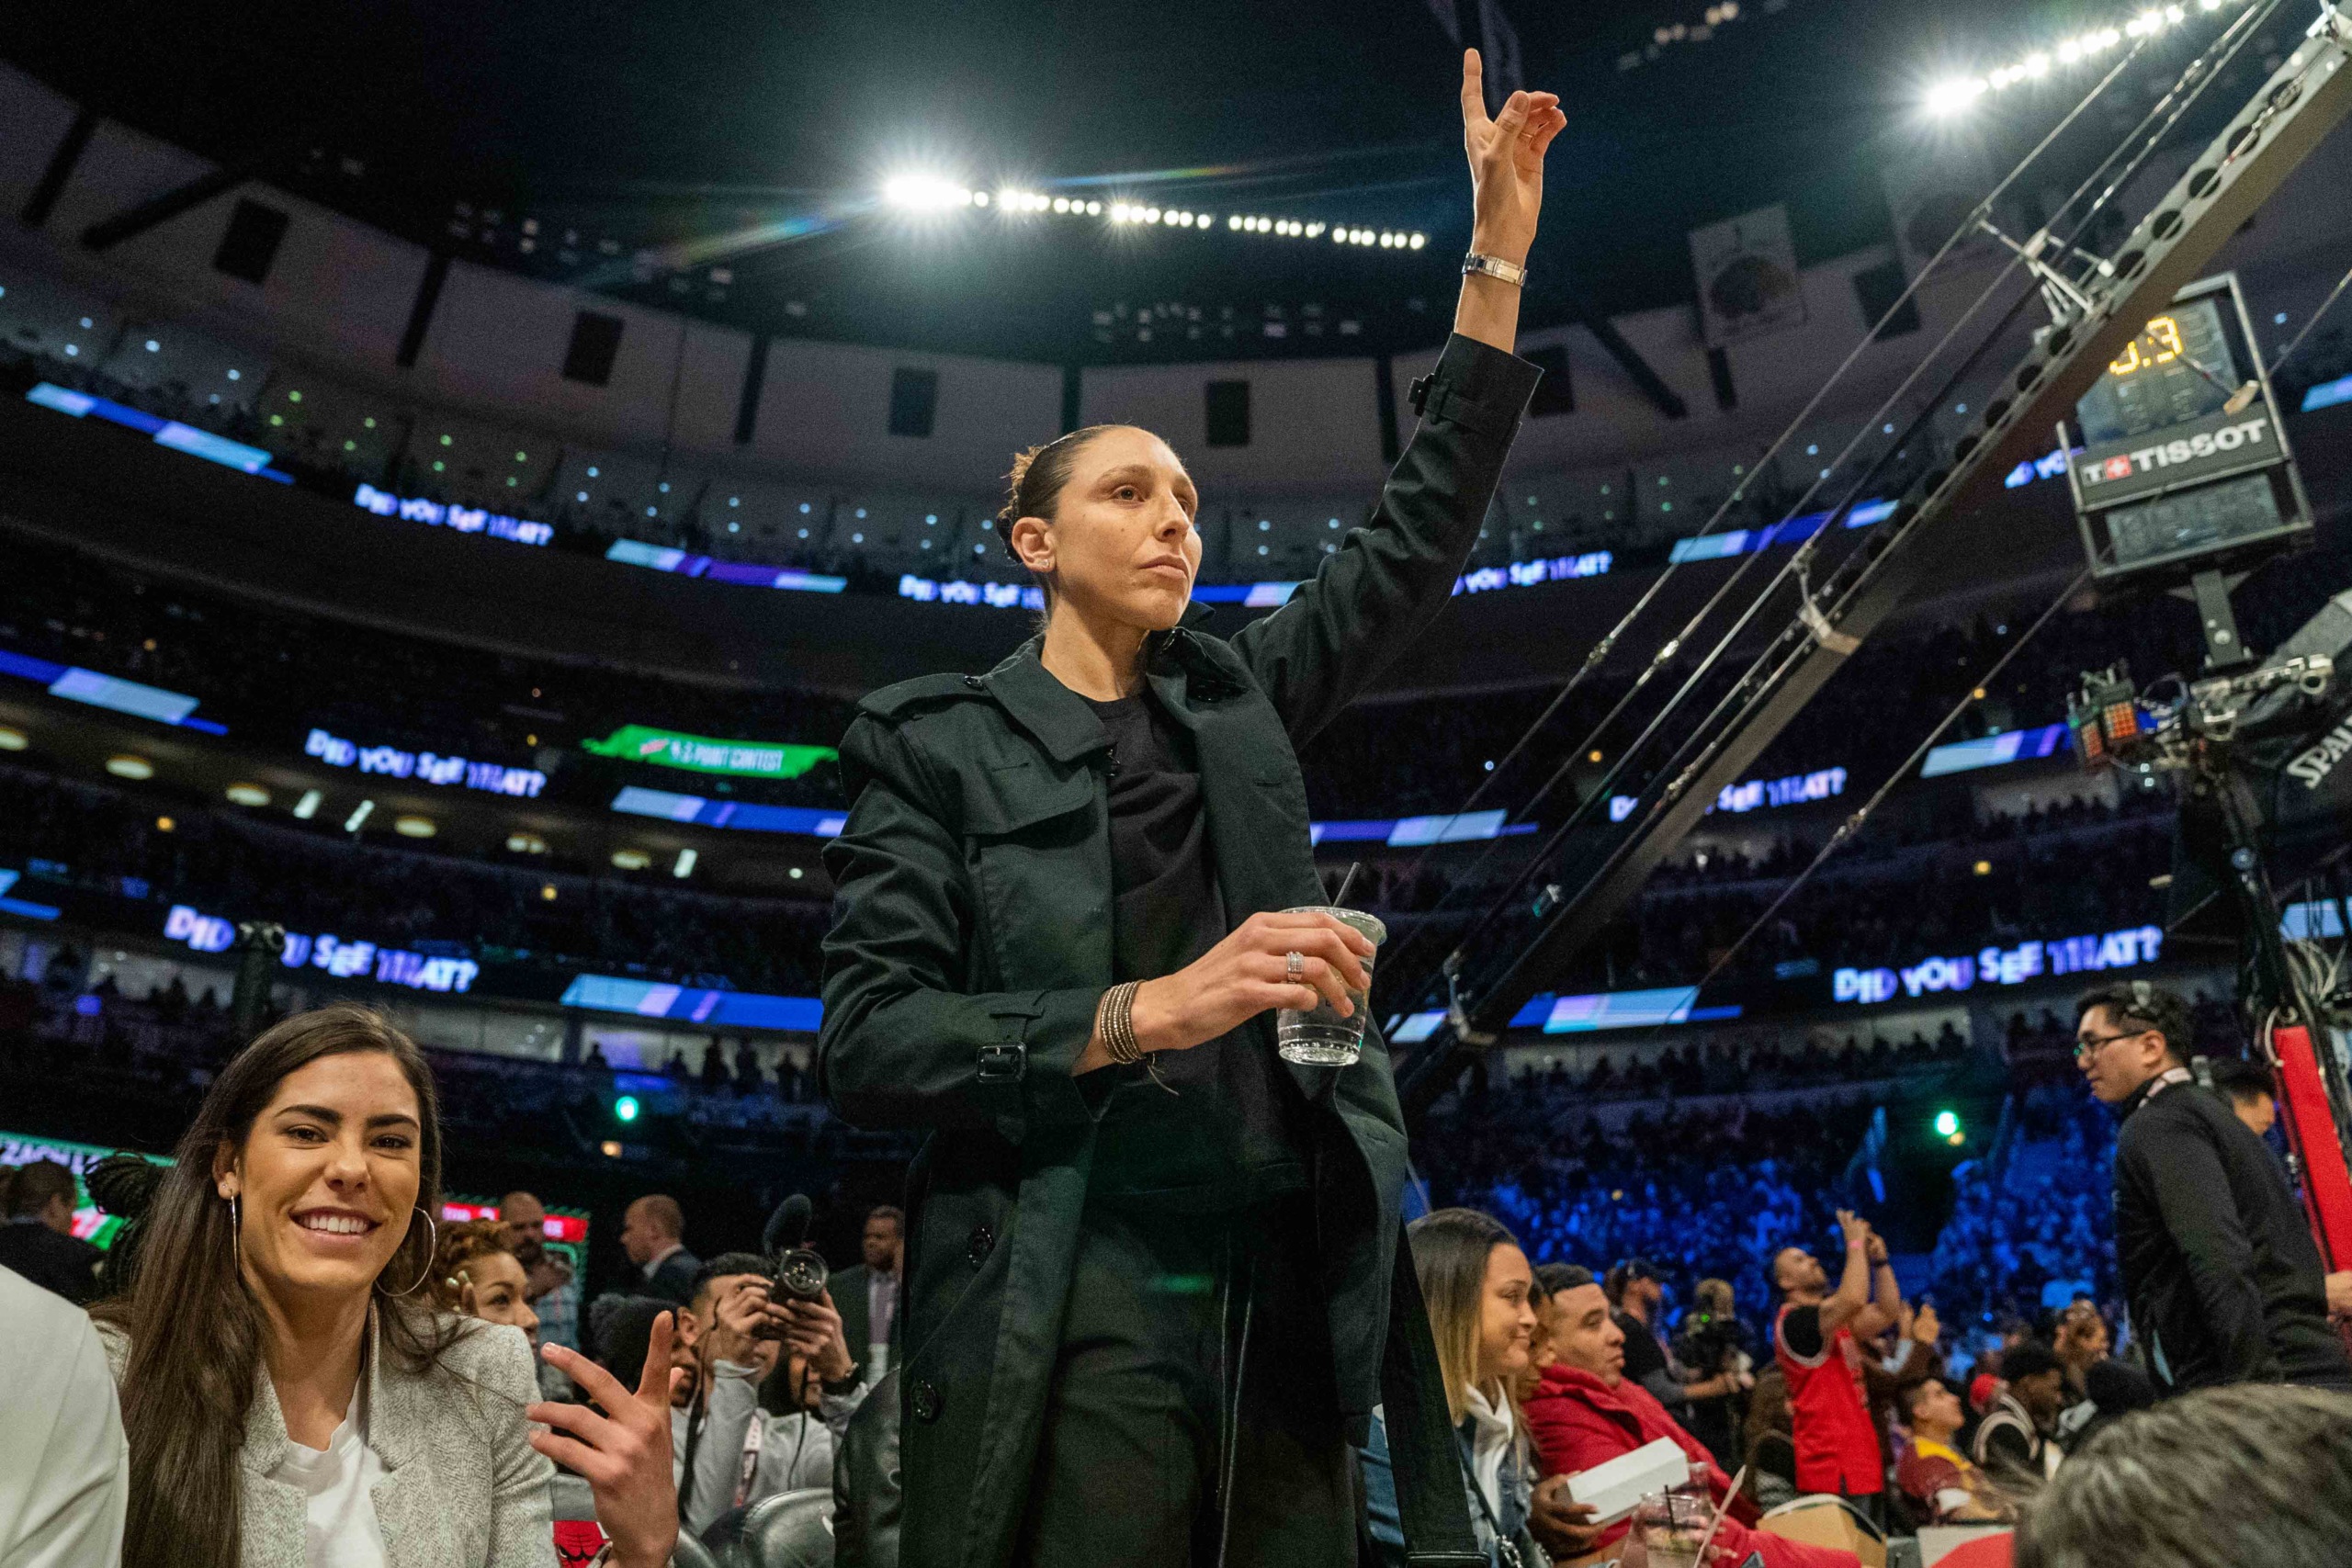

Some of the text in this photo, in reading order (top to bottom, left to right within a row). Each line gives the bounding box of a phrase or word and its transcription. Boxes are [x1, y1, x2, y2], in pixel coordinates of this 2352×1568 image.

[2130, 418, 2267, 472] TISSOT
[399, 497, 447, 526] YOU
[447, 504, 489, 533] SEE
[940, 580, 982, 605] YOU
[983, 581, 1021, 608] SEE
[1464, 568, 1509, 593] YOU
[1510, 560, 1548, 587] SEE
[358, 745, 414, 779] YOU
[415, 751, 467, 785] SEE
[2286, 715, 2352, 790] SPAL
[163, 904, 236, 953] DID
[311, 933, 377, 978] SEE
[376, 947, 481, 994] THAT?
[1833, 924, 2165, 1004] DID YOU SEE THAT?
